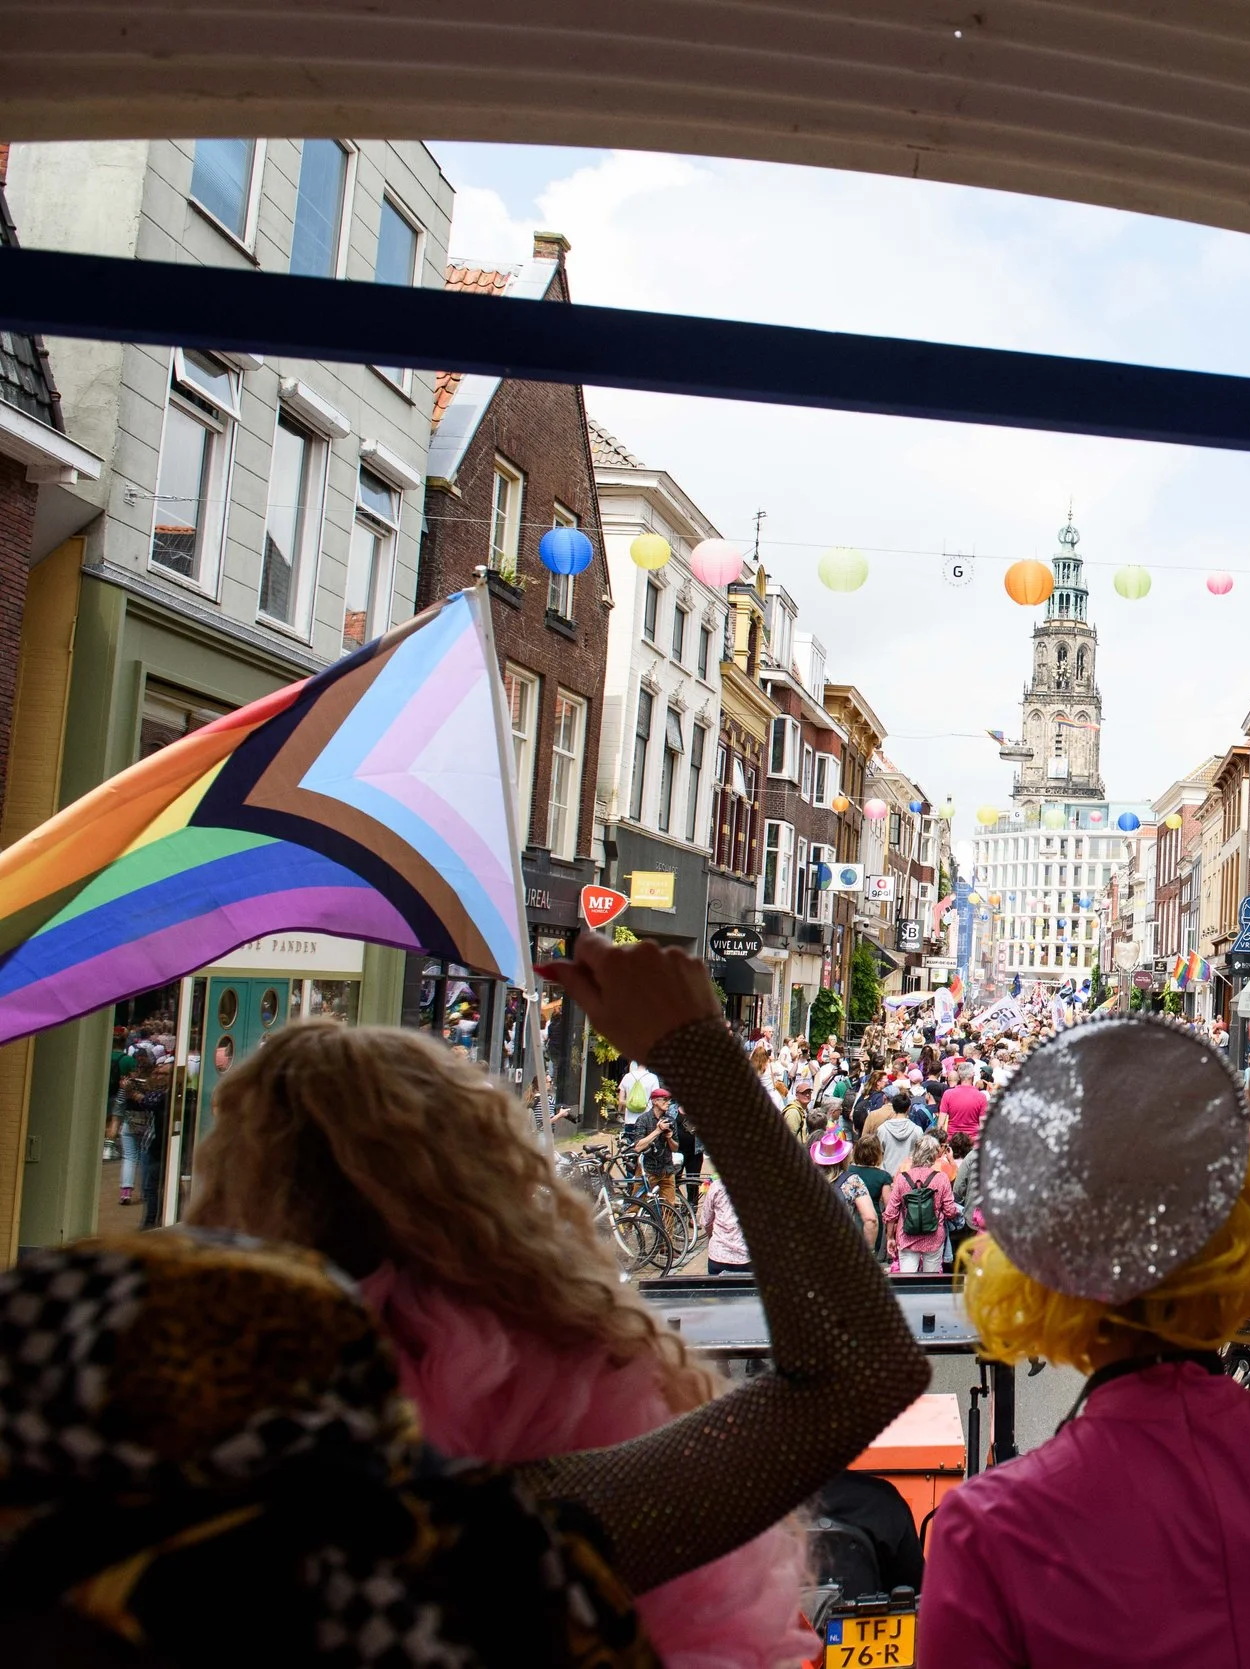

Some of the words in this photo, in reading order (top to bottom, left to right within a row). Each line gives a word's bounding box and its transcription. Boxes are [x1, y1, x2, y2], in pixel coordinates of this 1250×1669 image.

[953, 565, 963, 578] G
[589, 896, 613, 909] MF
[272, 940, 317, 953] PANDEN
[713, 940, 731, 950] VIVE
[733, 940, 743, 950] LA
[745, 941, 758, 951] VIE
[855, 1619, 902, 1641] TFJ
[840, 1643, 900, 1668] 76-R
